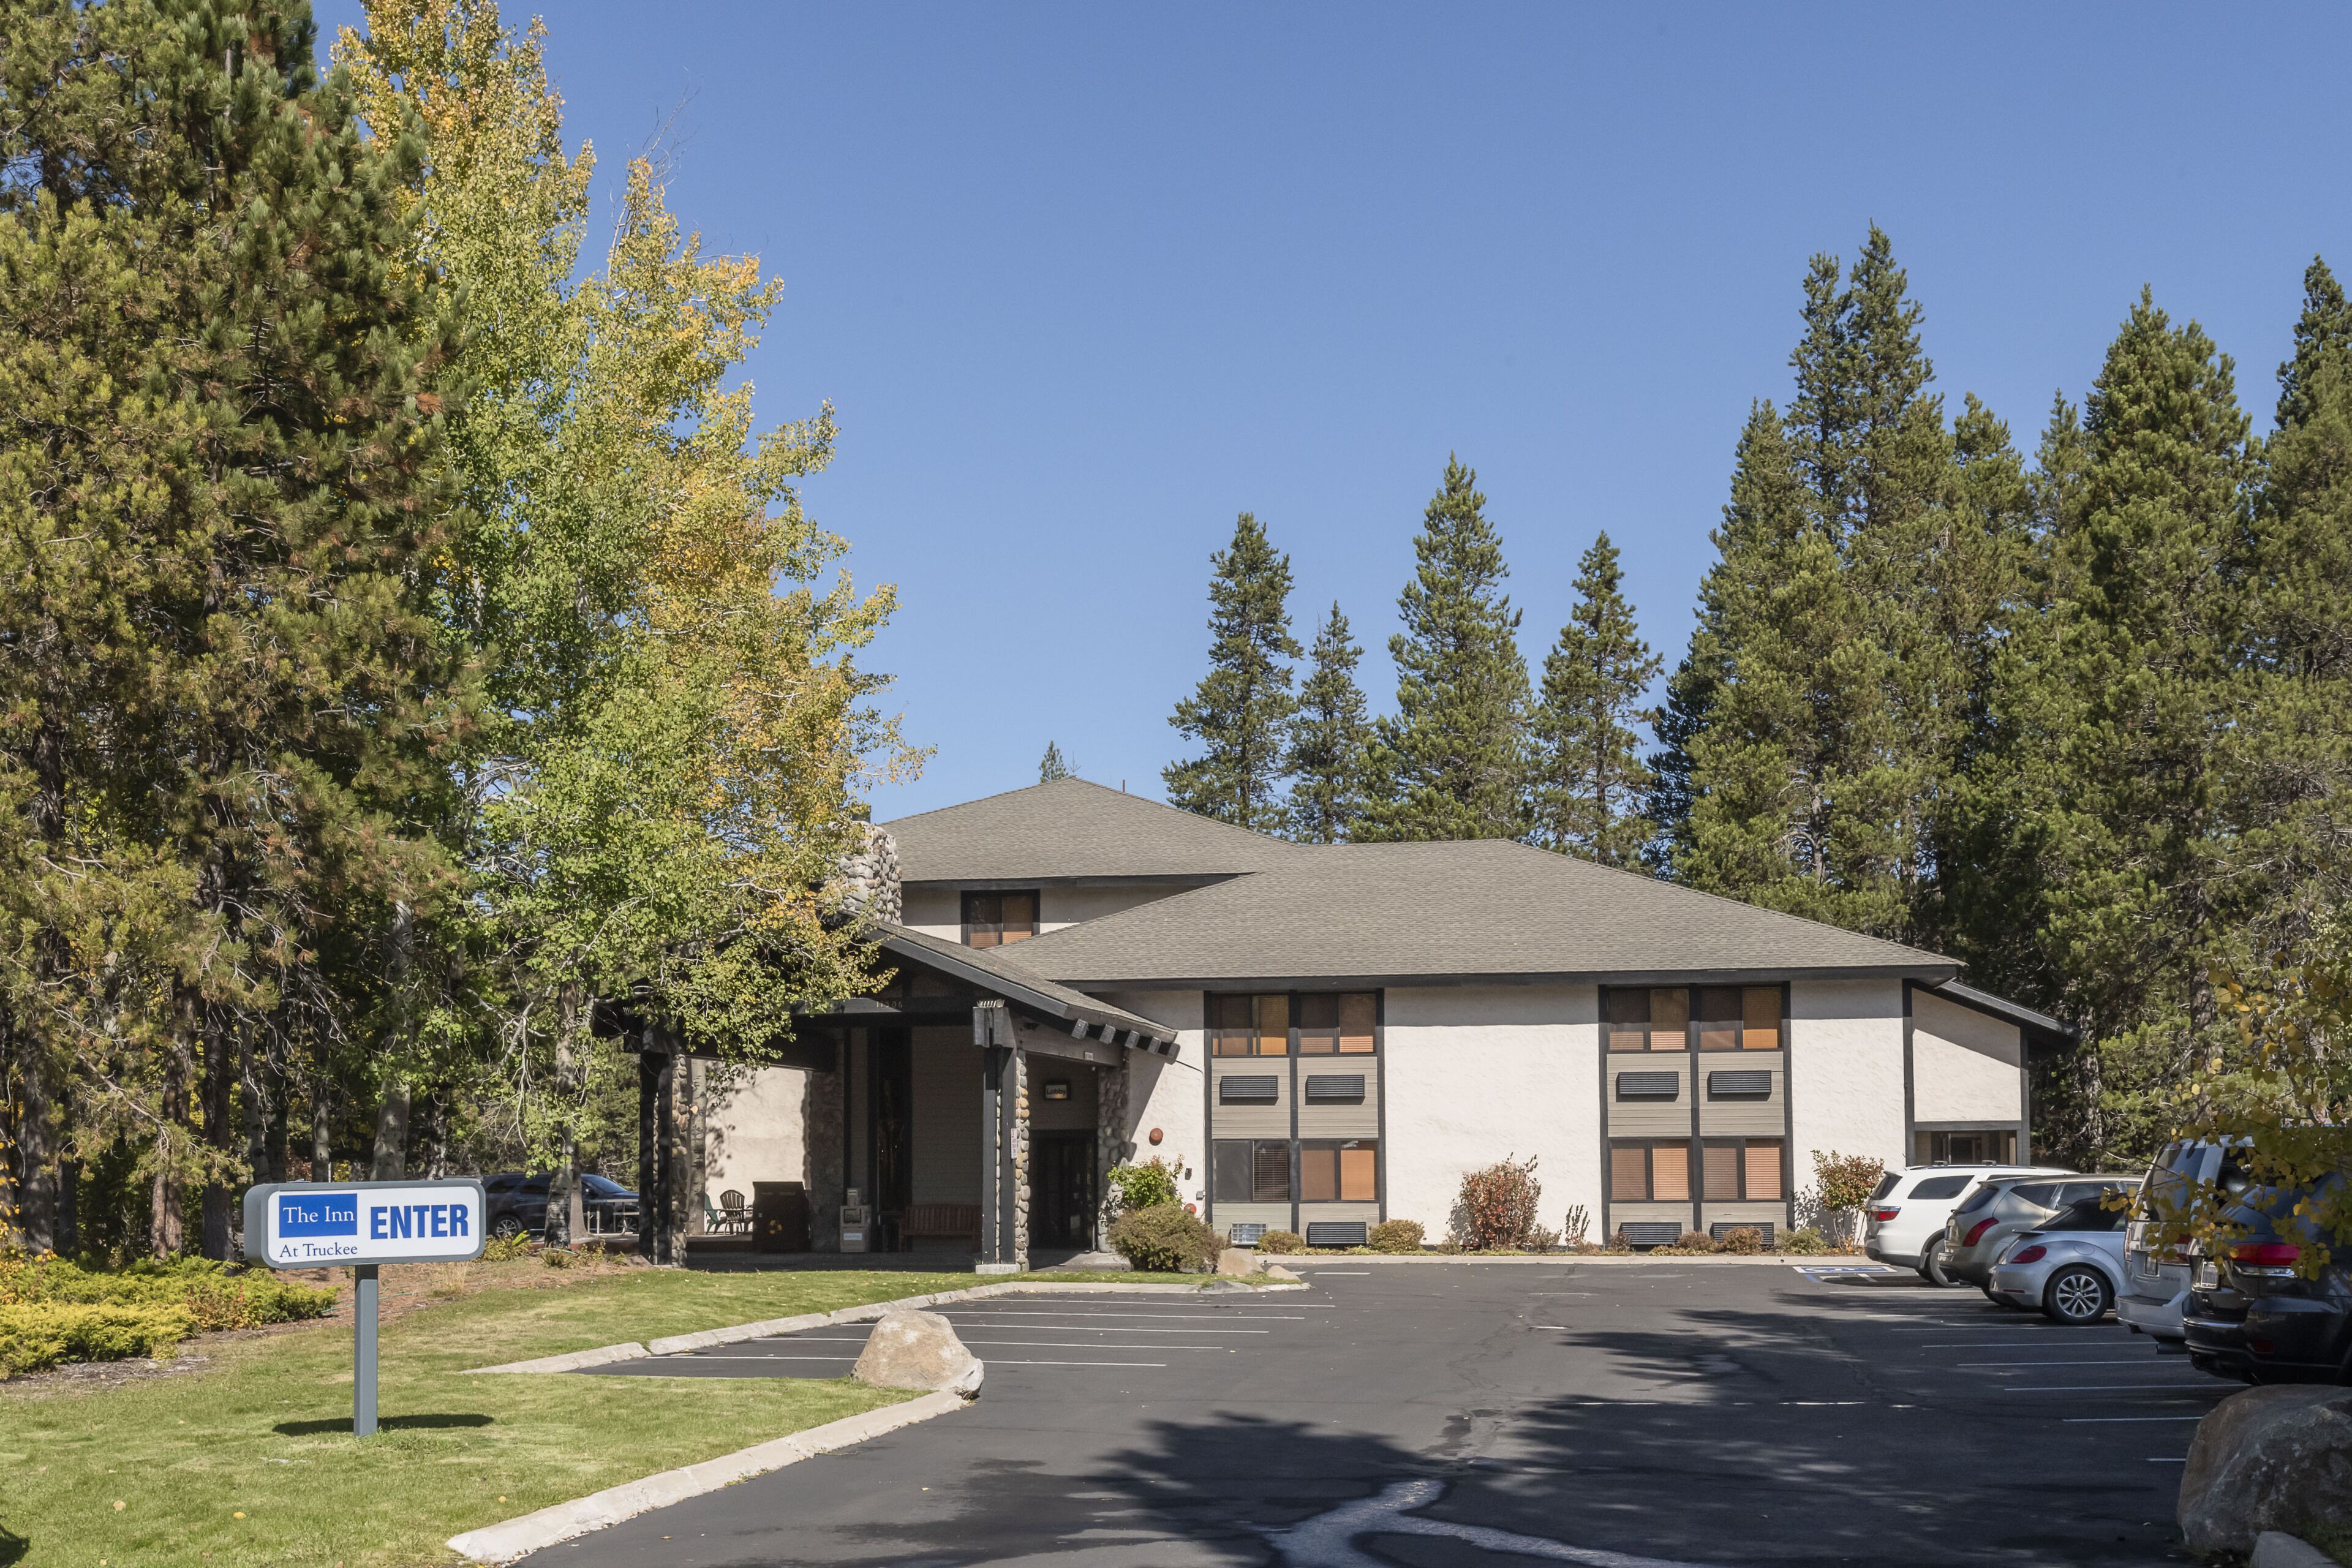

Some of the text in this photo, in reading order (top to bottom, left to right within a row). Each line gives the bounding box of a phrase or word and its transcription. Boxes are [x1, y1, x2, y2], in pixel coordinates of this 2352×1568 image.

[282, 1205, 355, 1224] The Inn
[371, 1204, 469, 1240] ENTER
[279, 1242, 358, 1258] At Truckee
